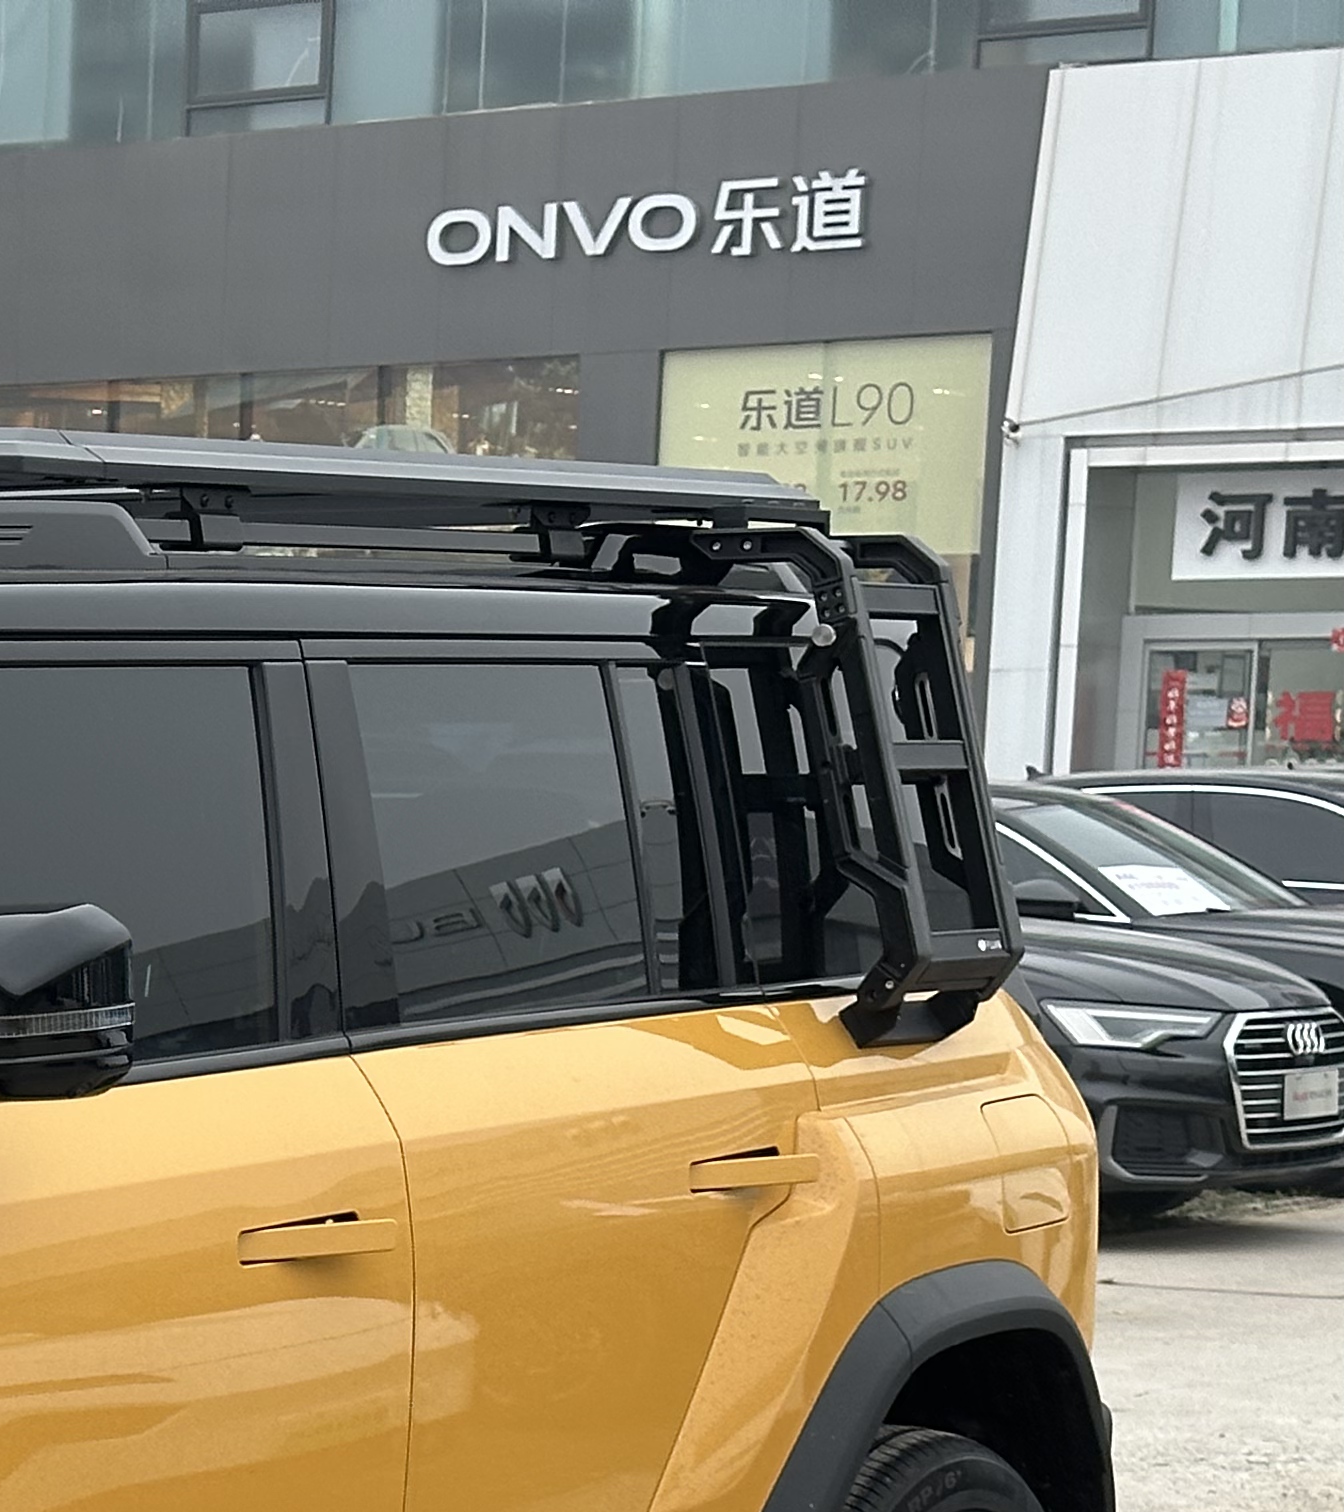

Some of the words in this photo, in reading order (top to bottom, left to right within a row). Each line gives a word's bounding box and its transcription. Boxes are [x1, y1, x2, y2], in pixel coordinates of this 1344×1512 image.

[426, 193, 698, 266] ONVO
[711, 168, 868, 257] 乐道
[838, 479, 908, 503] 17.98
